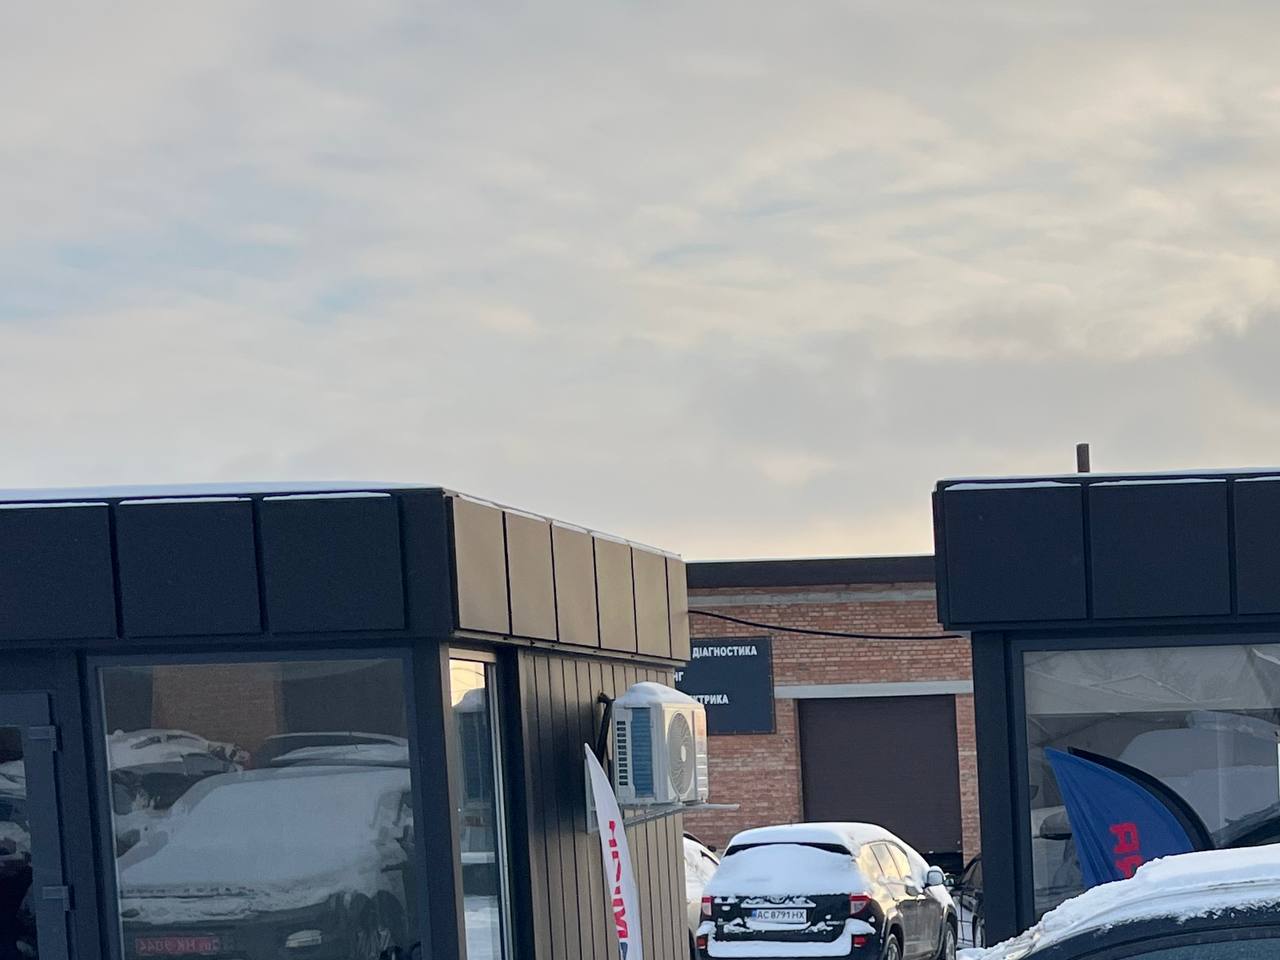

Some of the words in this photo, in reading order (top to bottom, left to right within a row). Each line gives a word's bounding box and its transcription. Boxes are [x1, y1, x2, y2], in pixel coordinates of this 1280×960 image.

[692, 645, 758, 658] ДІАГНОСТИКА
[757, 910, 770, 919] AC
[770, 910, 791, 919] 8791
[791, 910, 805, 919] HX
